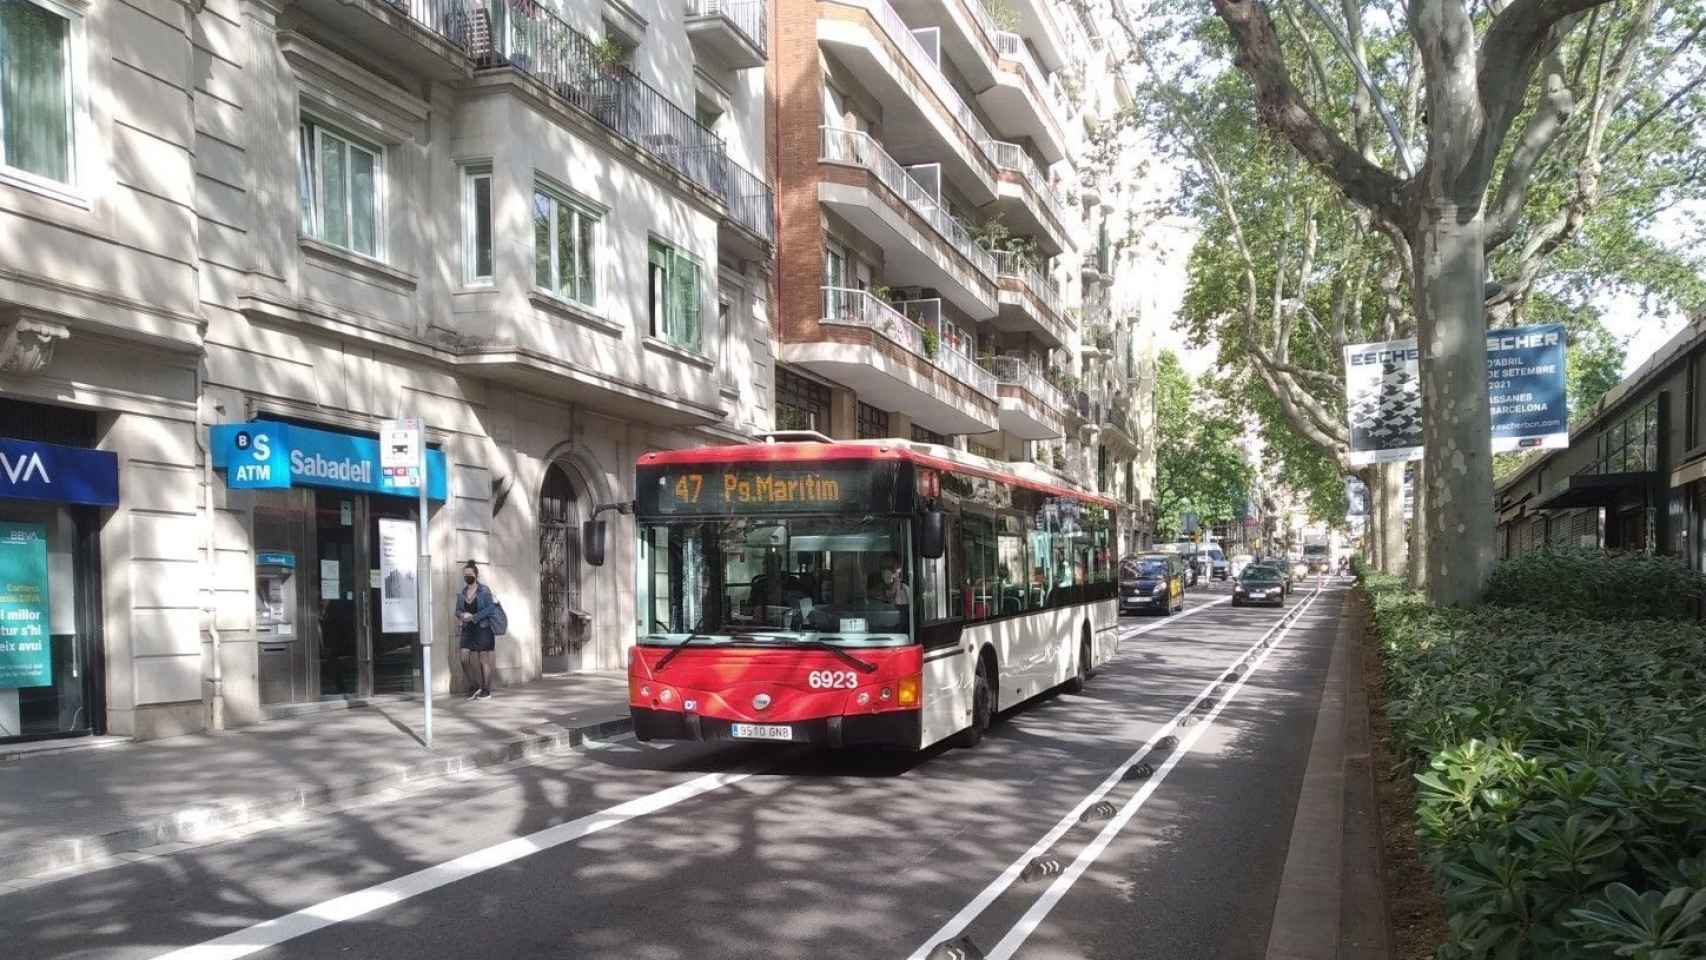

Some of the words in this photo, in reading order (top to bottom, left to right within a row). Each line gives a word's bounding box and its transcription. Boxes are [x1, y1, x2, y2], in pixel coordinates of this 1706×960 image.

[1487, 333, 1559, 351] SCHER
[1351, 349, 1418, 366] ESCHE
[1502, 364, 1556, 378] SETEMBRE
[1488, 381, 1511, 390] 2021
[1490, 403, 1548, 416] BARCELONA
[0, 451, 51, 485] VA
[236, 464, 271, 481] ATM
[290, 449, 371, 484] Sabadell
[675, 474, 704, 503] 47
[8, 608, 40, 620] millor
[19, 640, 42, 651] avui
[808, 671, 858, 688] 6923
